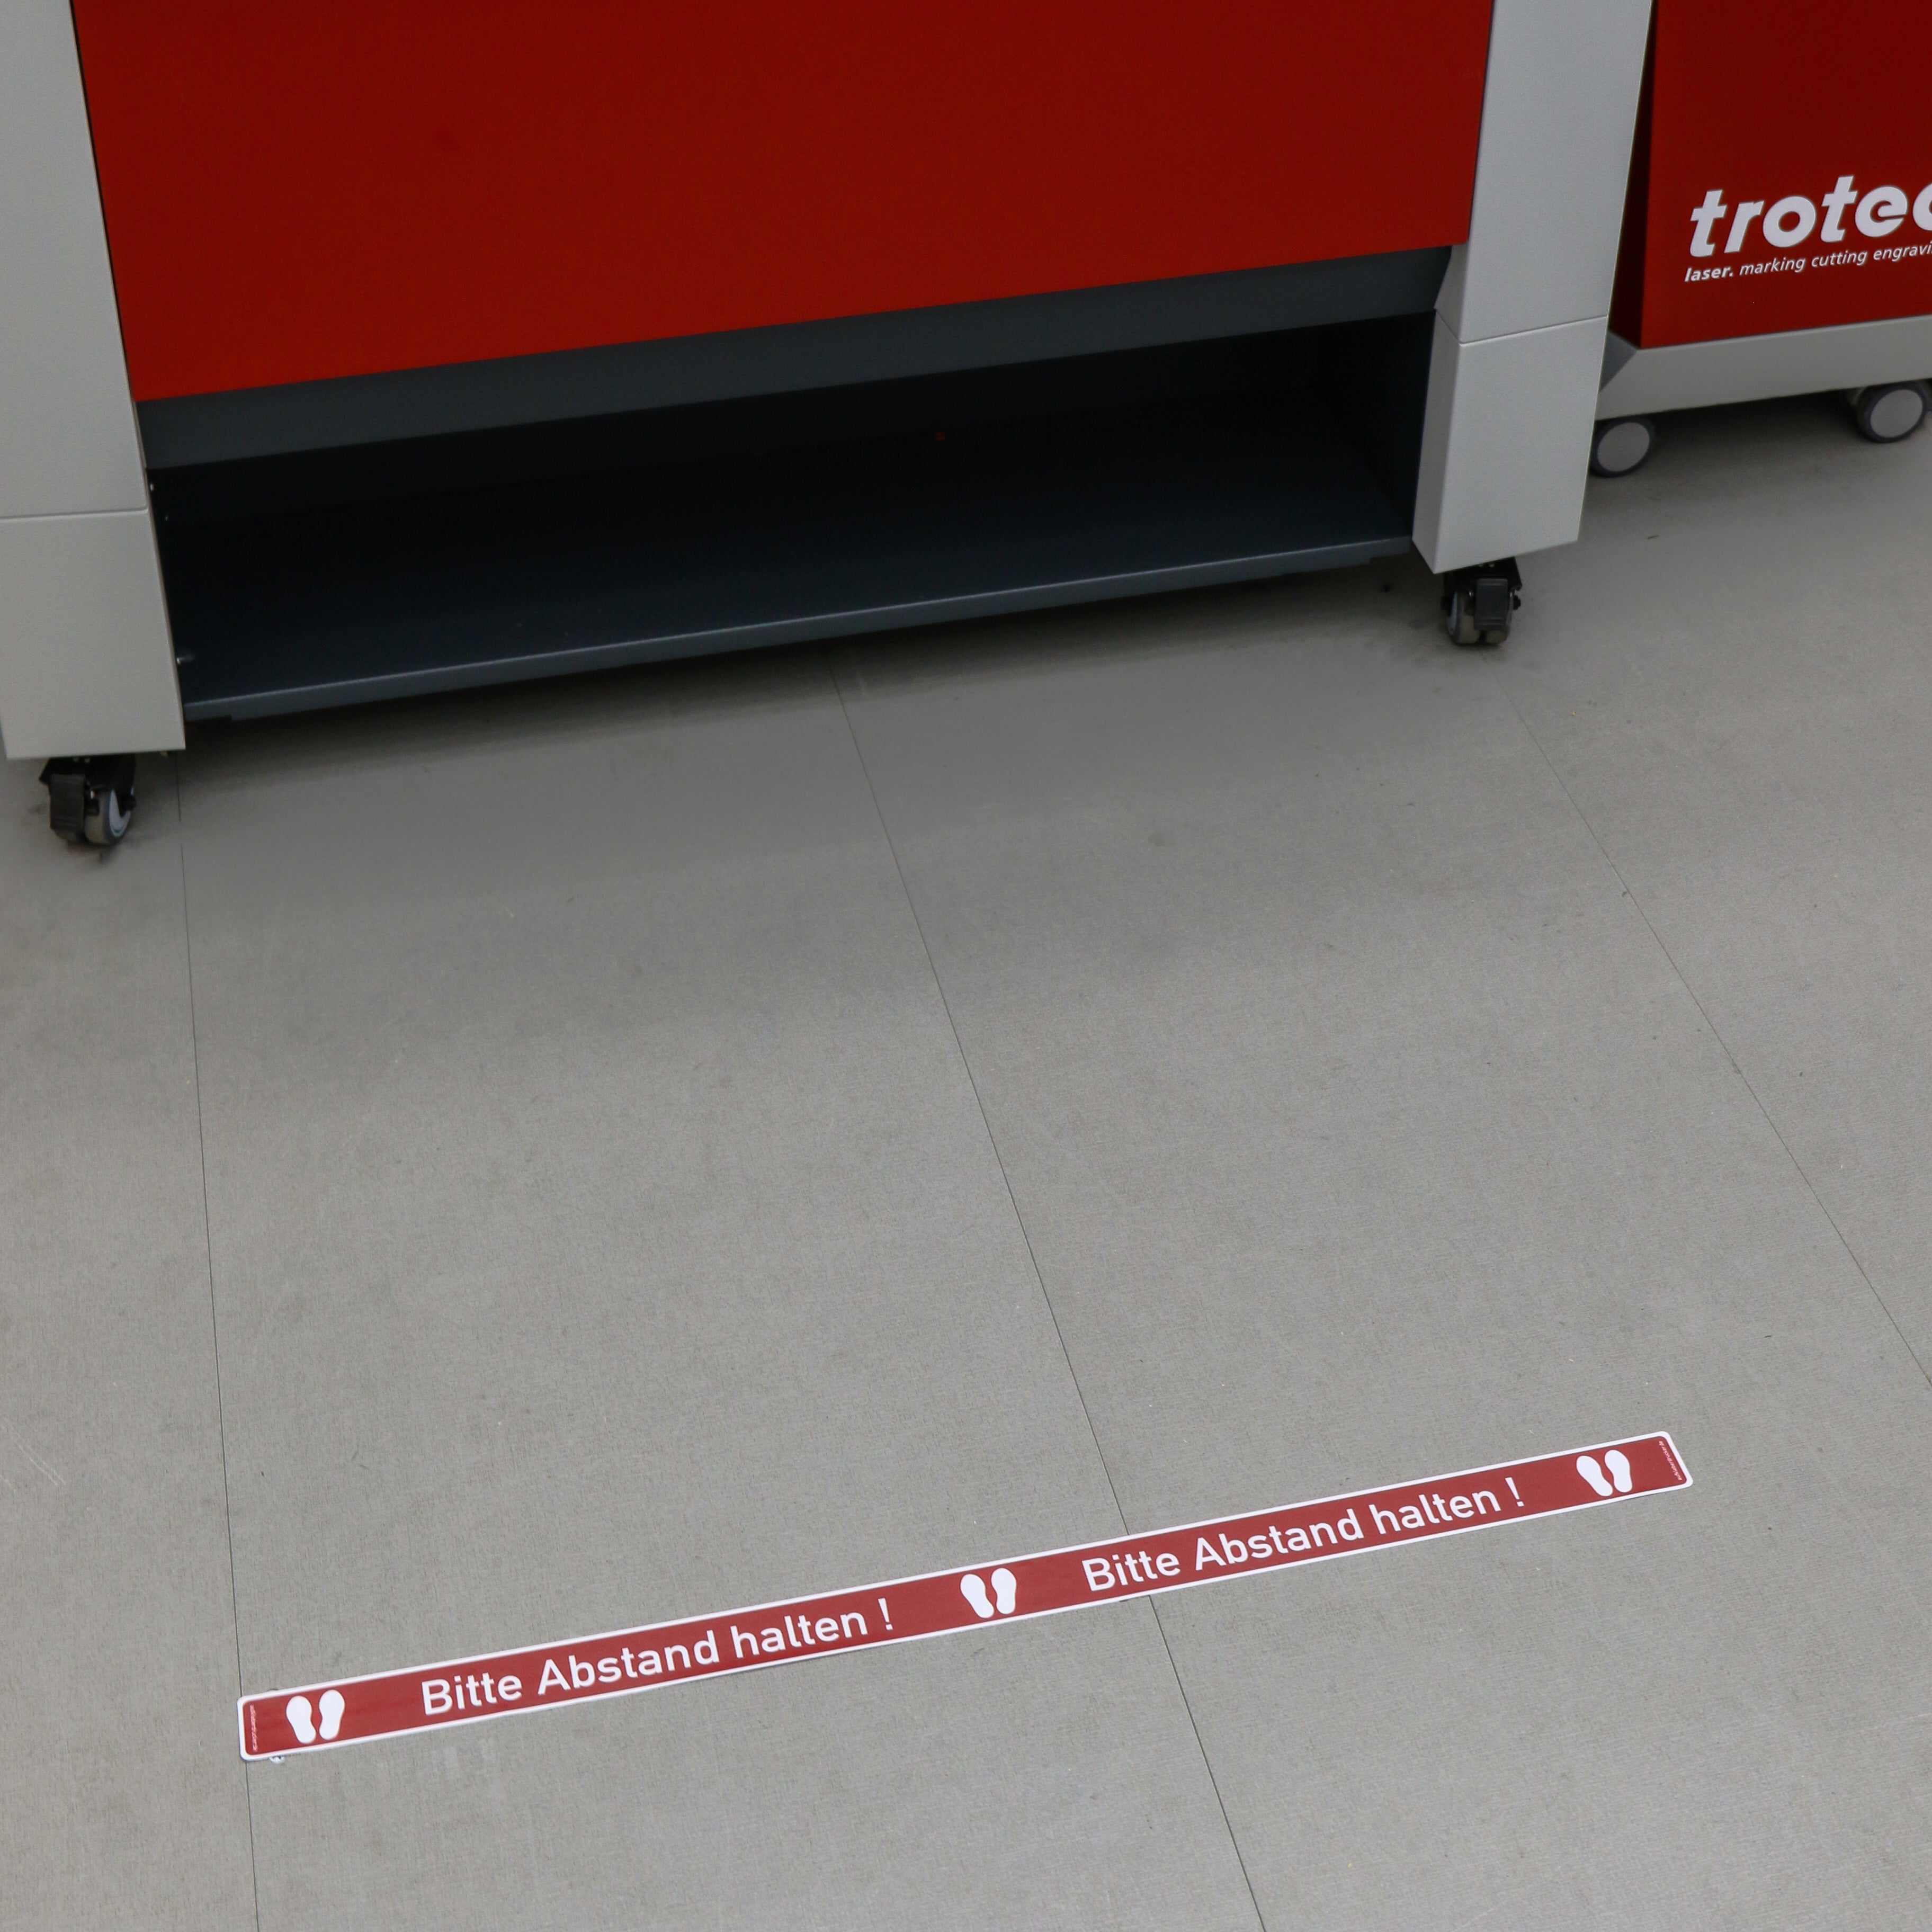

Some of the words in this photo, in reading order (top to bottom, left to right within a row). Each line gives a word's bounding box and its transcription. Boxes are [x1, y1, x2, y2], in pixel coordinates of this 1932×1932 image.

[1684, 267, 1733, 282] laser.
[1739, 256, 1806, 276] marking
[1811, 250, 1868, 267] cutting
[1873, 240, 1932, 262] engravi
[1081, 1551, 1180, 1591] Bitte
[1195, 1508, 1364, 1571] Abstand
[1368, 1490, 1501, 1534] halten
[1505, 1477, 1524, 1507] !
[422, 1672, 522, 1715] Bitte
[538, 1630, 720, 1695] Abstand
[730, 1612, 868, 1658] halten
[878, 1598, 893, 1630] !
